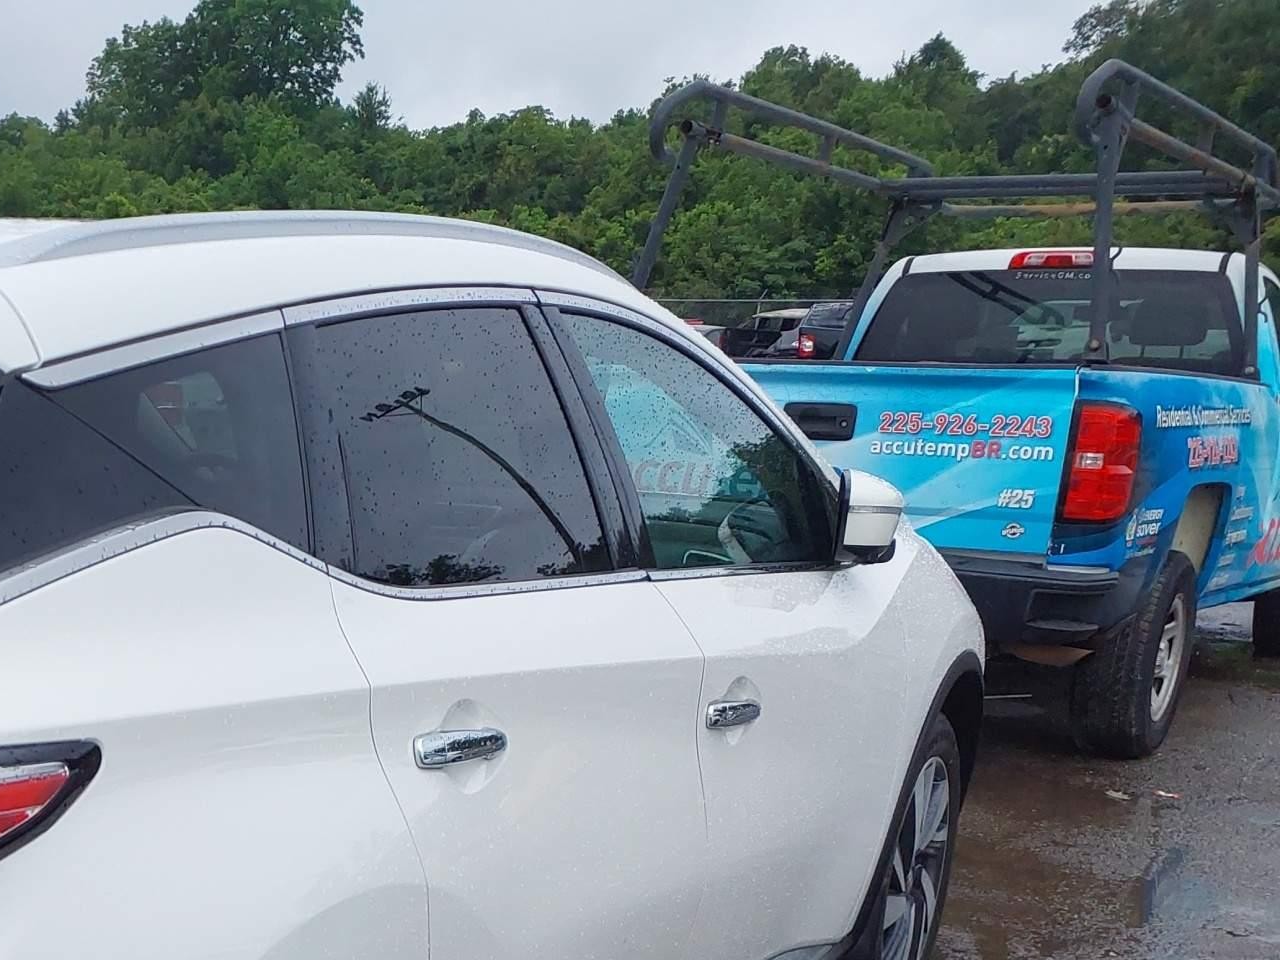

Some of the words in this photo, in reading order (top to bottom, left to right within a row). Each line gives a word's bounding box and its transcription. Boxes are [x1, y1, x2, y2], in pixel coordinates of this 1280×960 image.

[877, 411, 1053, 438] 225-926-2243
[870, 438, 1054, 462] accutempBR.com
[996, 489, 1036, 508] #25
